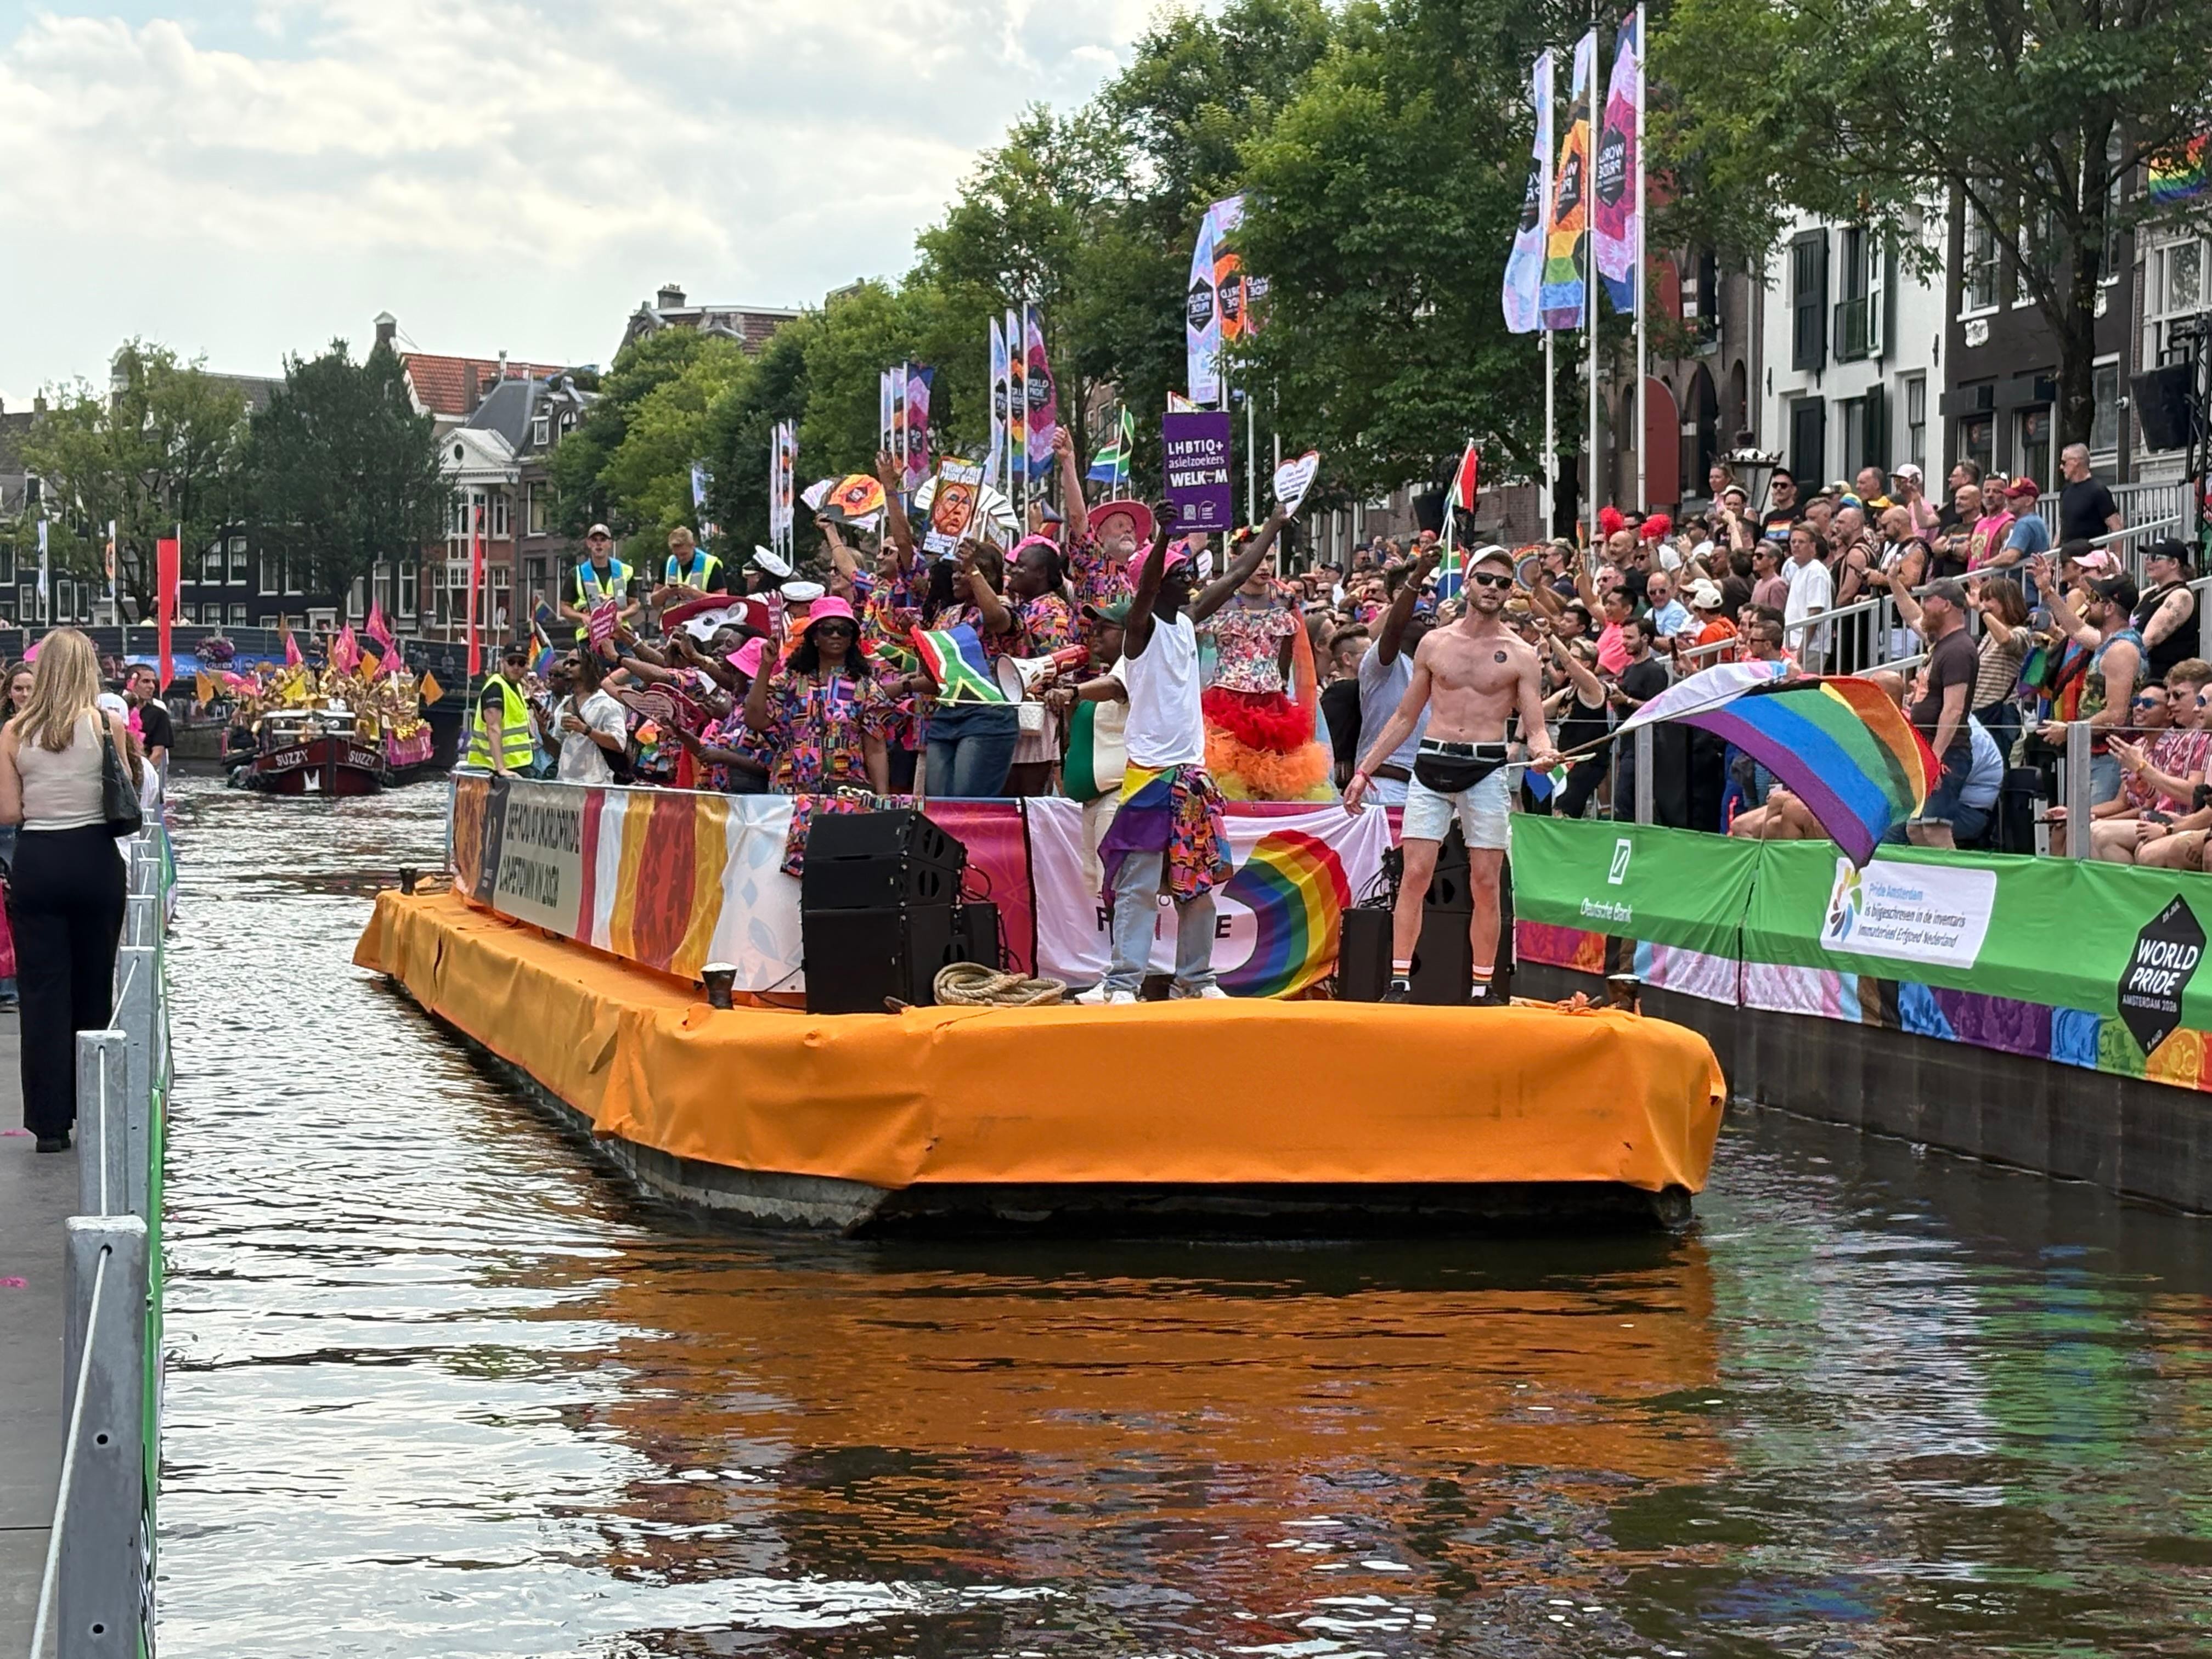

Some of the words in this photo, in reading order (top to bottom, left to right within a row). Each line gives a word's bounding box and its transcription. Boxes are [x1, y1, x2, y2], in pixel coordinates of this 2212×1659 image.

[1168, 439, 1224, 455] LHBTIQ+
[1169, 454, 1225, 469] asielzoekers
[275, 749, 308, 766] SUZZY
[348, 750, 376, 766] SUZZY
[1869, 882, 1886, 897] Pride
[1886, 885, 1923, 901] Amsterdam
[1580, 897, 1613, 921] Deutsche
[1613, 901, 1633, 924] Bank
[1864, 901, 1871, 917] is
[1922, 909, 1933, 924] de
[1932, 909, 1966, 928] inventaris
[1895, 927, 1924, 945] Erfgoed
[1922, 930, 1959, 949] Nederland
[2136, 938, 2198, 970] WORLD
[2129, 967, 2181, 996] PRIDE
[2122, 994, 2161, 1009] AMSTERDAM
[2162, 999, 2177, 1013] 2026
